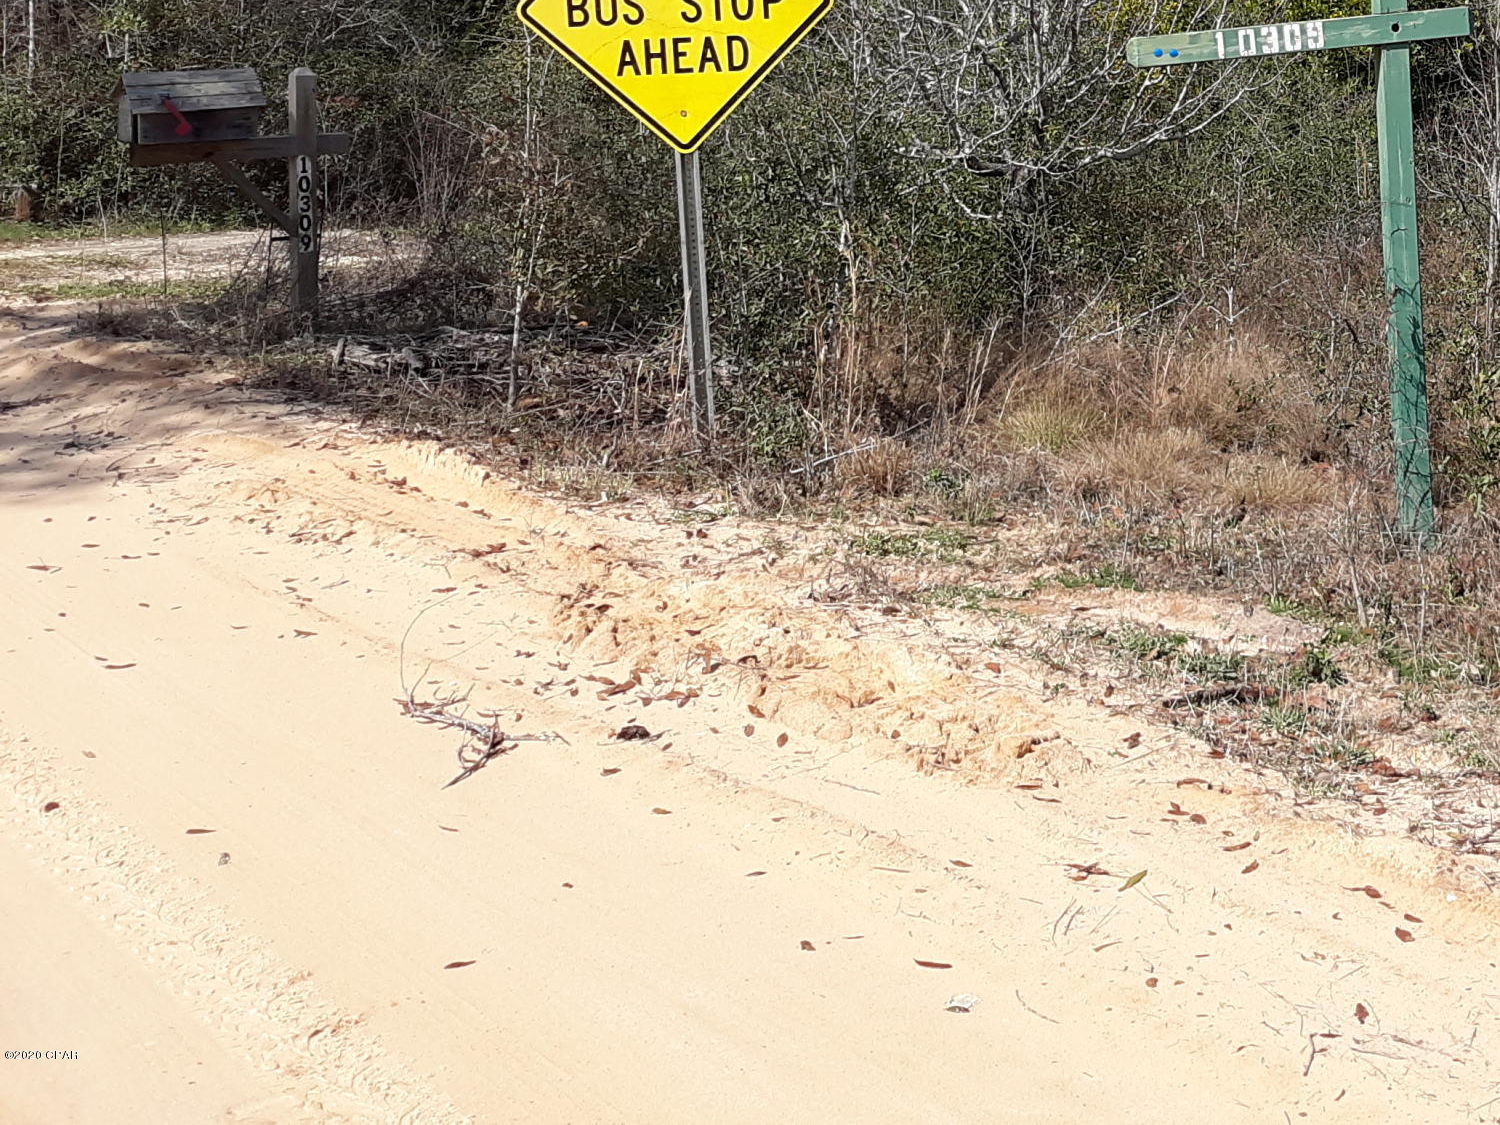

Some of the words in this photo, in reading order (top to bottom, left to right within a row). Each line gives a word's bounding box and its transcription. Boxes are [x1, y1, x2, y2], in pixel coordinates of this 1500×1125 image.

[617, 35, 750, 77] AHEAD
[1215, 21, 1324, 59] 10309
[298, 156, 312, 251] 10309
